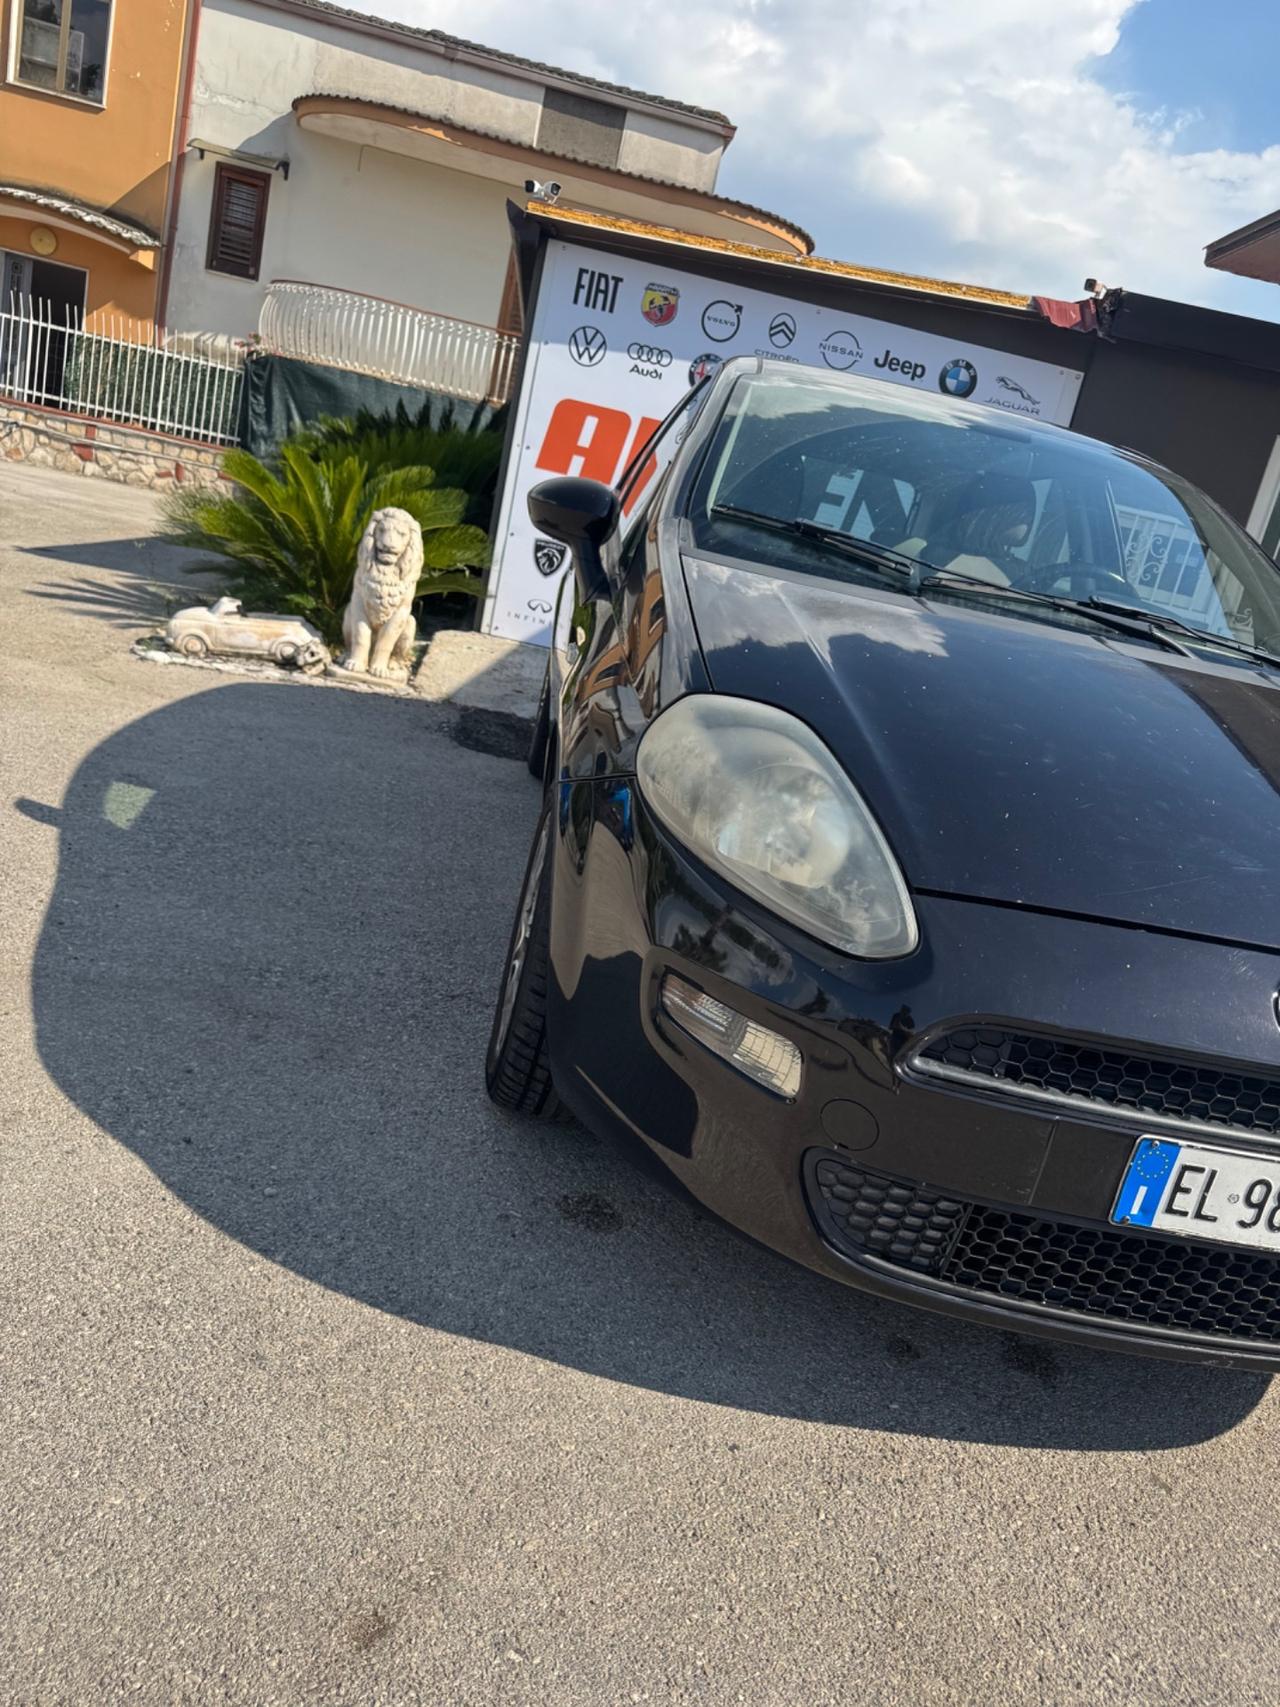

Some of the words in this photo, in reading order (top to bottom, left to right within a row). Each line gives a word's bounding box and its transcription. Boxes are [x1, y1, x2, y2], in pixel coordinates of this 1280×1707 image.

[572, 267, 624, 314] FIAT
[706, 315, 736, 327] VOLVO
[818, 342, 864, 360] NISSAN
[629, 364, 662, 381] Audi
[873, 349, 926, 381] Jeep
[984, 397, 1041, 415] JAGUAR
[1165, 1164, 1218, 1223] EL
